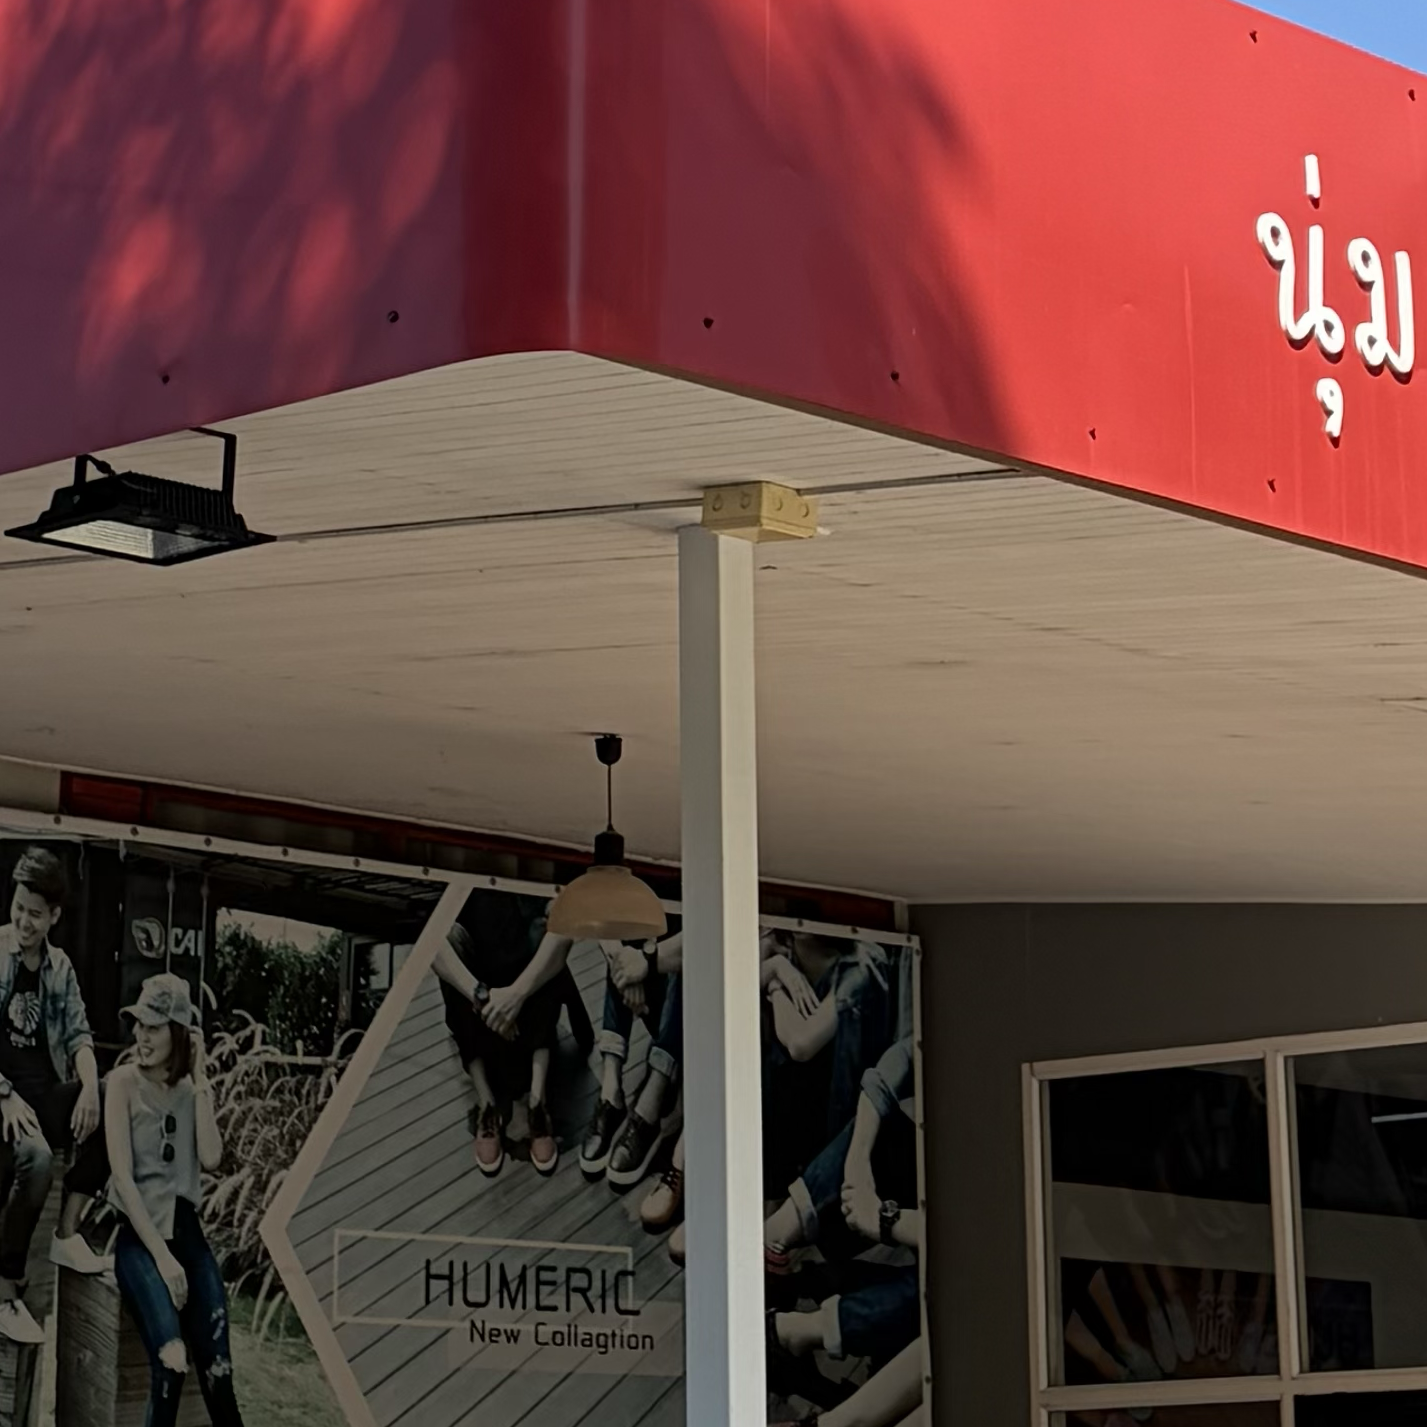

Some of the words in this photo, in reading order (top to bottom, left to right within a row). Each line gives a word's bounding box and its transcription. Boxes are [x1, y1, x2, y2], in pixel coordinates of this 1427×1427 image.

[1255, 153, 1417, 440] นุ่ม
[425, 1259, 641, 1316] HUMERIC
[470, 1319, 521, 1345] New
[535, 1322, 655, 1354] Collagtion
